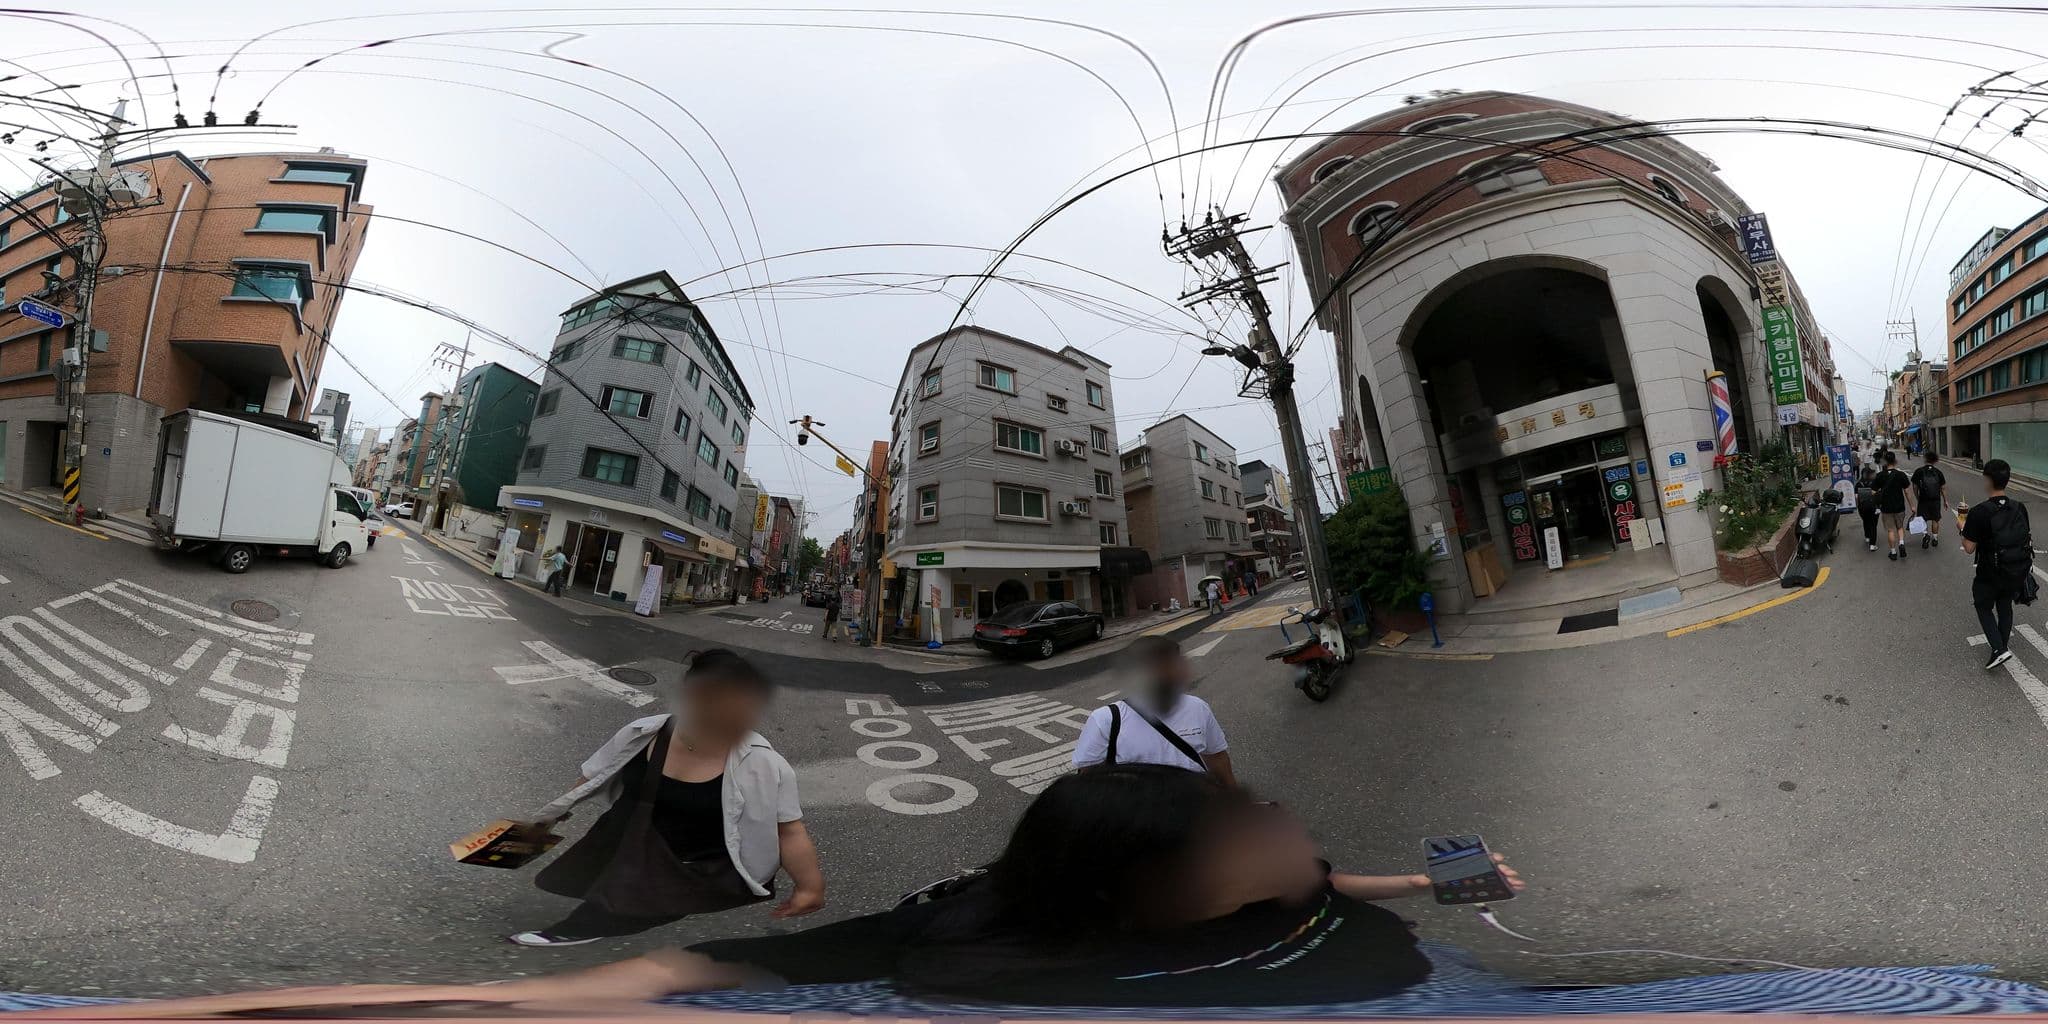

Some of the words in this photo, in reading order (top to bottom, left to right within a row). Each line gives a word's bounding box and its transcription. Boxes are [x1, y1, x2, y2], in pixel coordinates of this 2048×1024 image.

[1747, 220, 1768, 250] 세무사
[1767, 310, 1799, 393] 럭키할인마트
[1512, 523, 1536, 560] 사우나
